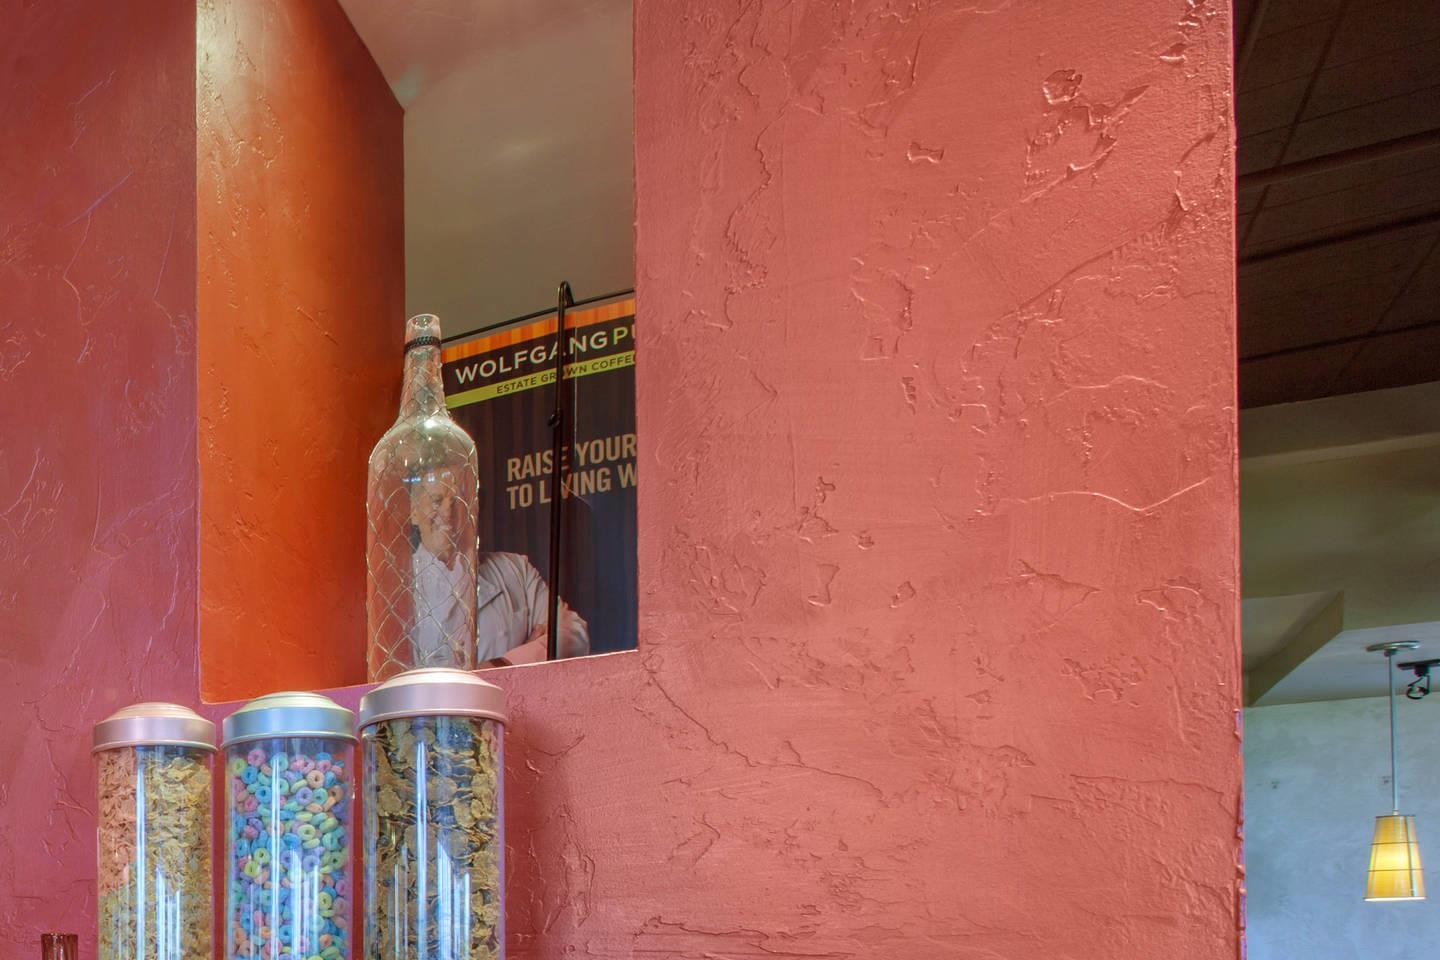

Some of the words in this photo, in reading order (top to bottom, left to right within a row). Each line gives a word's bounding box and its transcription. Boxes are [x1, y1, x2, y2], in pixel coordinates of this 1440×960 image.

[496, 376, 537, 395] ESTATE
[541, 367, 587, 384] GRWN
[576, 433, 637, 467] YOUR
[506, 483, 533, 510] TO
[539, 467, 612, 504] LVING
